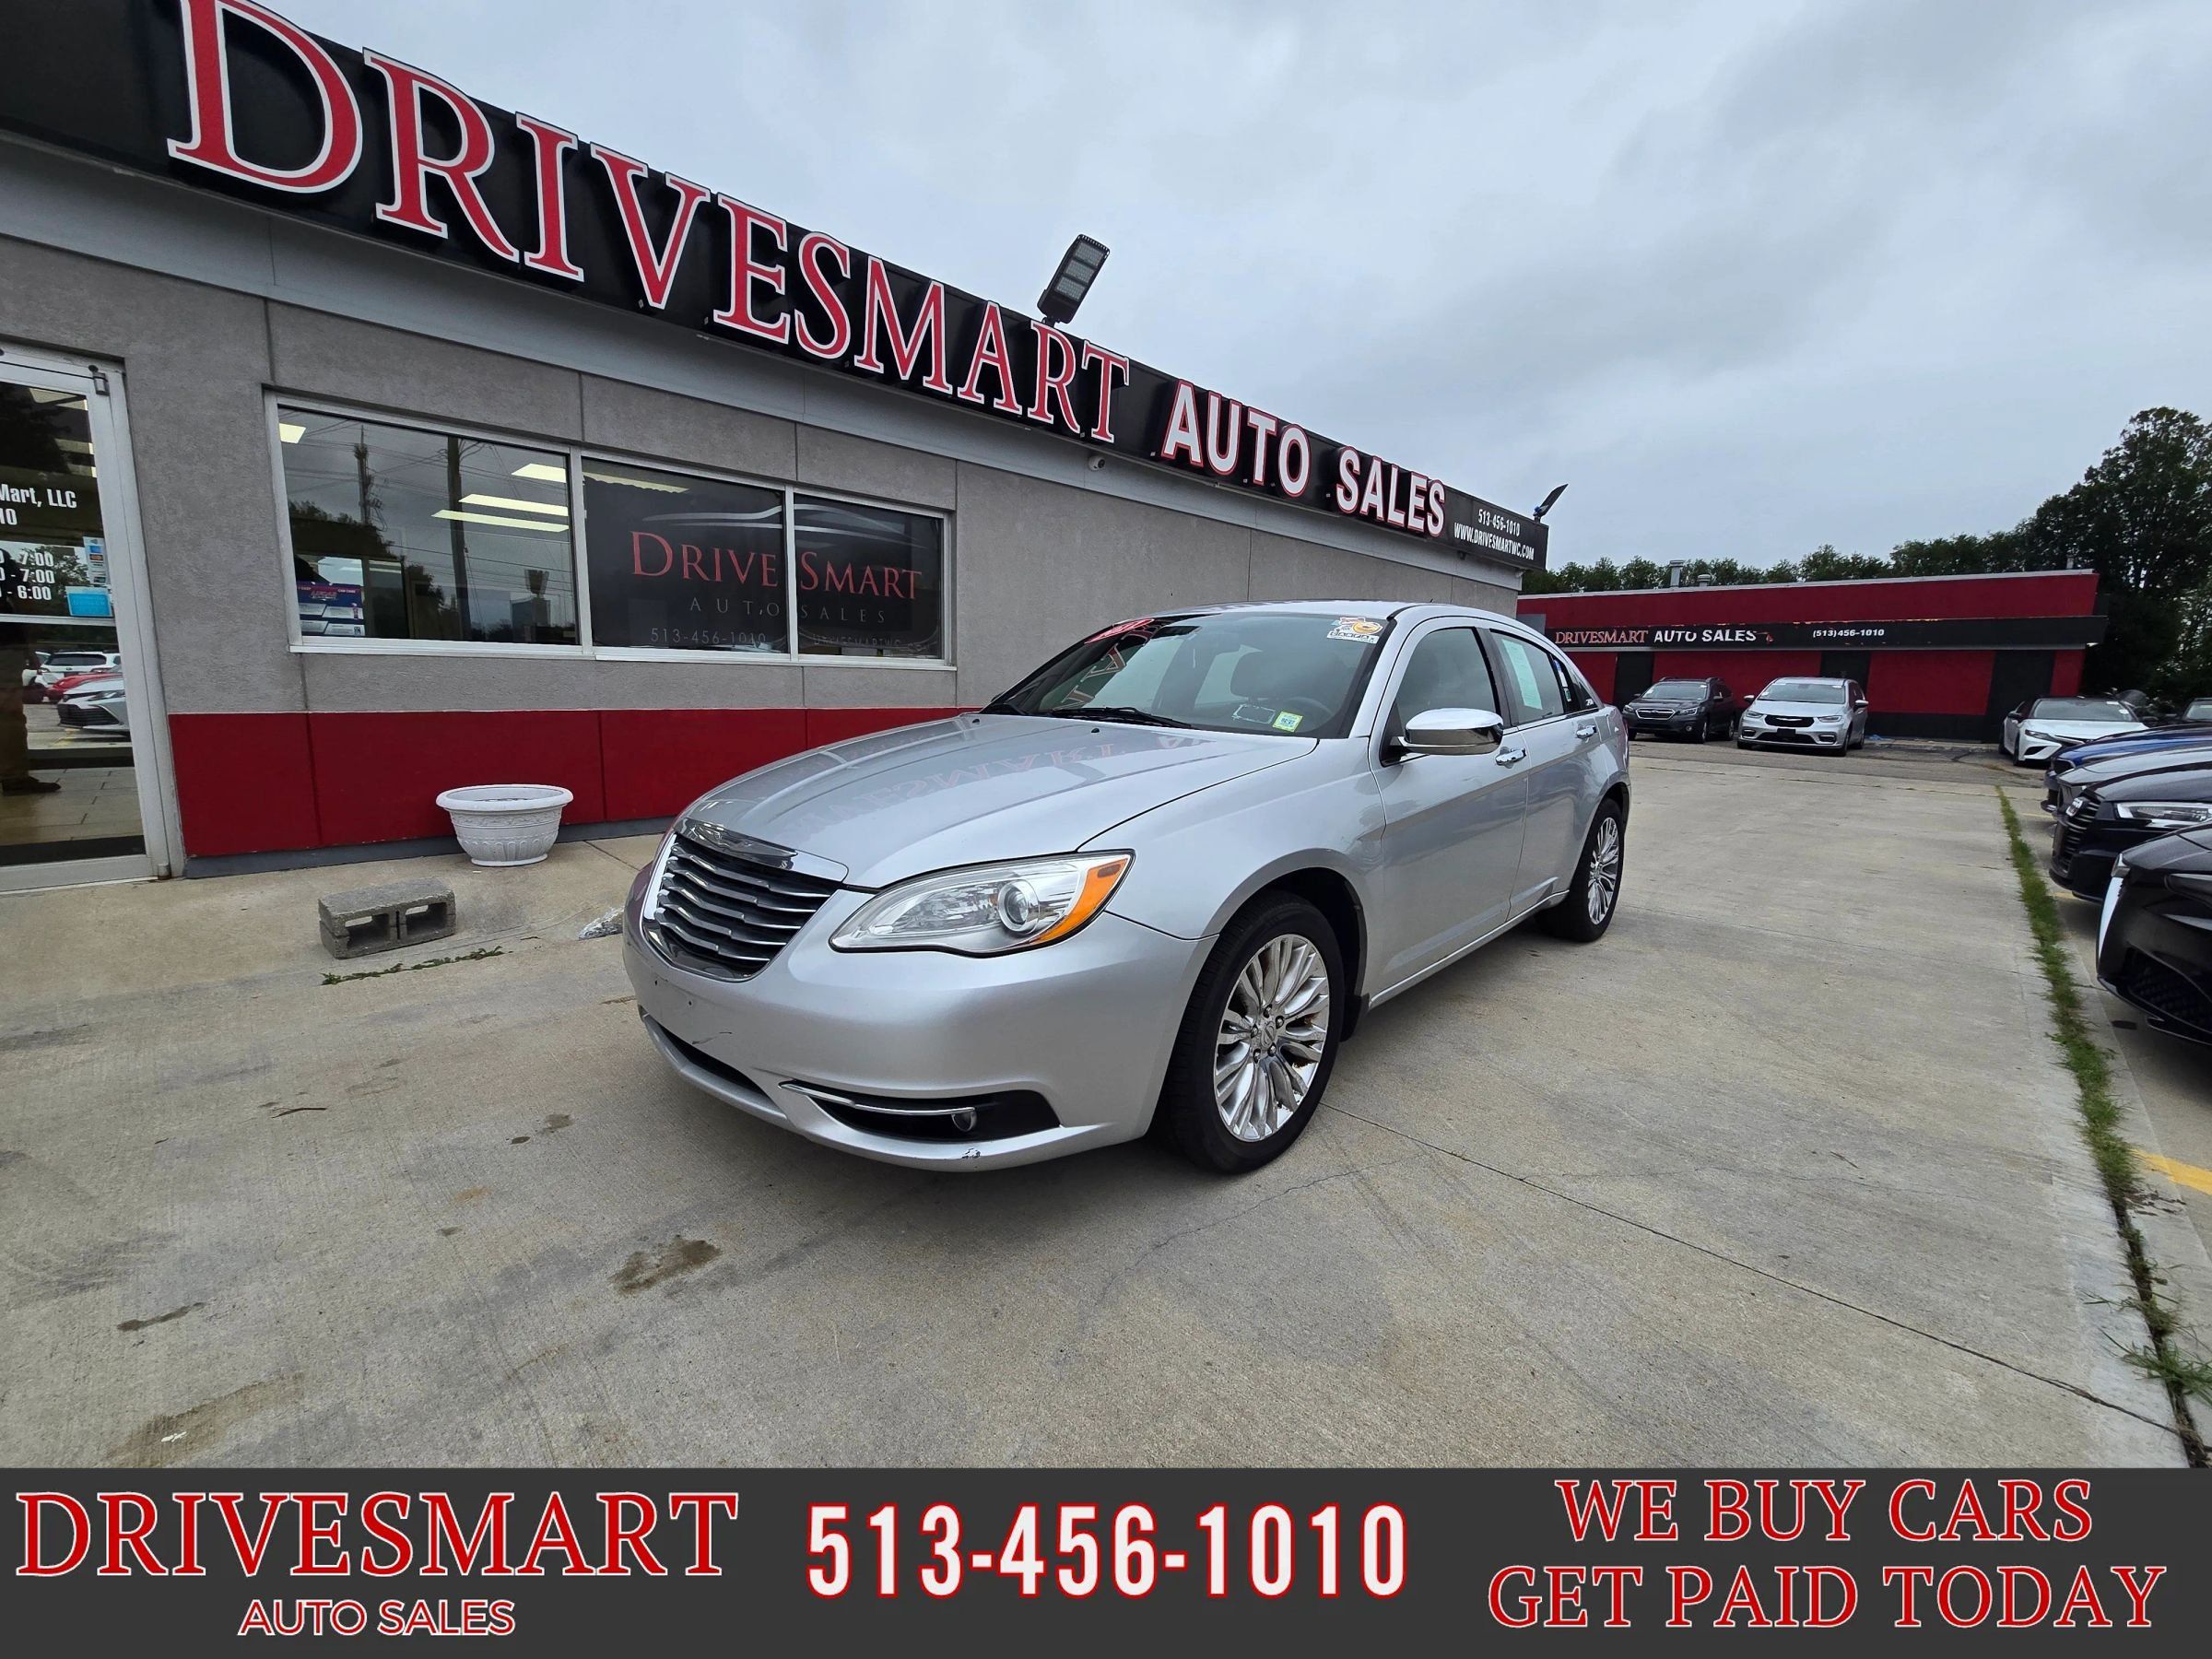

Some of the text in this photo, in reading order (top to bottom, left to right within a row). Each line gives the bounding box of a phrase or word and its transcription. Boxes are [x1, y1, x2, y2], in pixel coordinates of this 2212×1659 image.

[167, 0, 1130, 445] DRIVESMART
[1160, 378, 1446, 537] AUTO SALES
[46, 488, 77, 509] LLC
[1477, 508, 1521, 537] 513-456-1010
[1453, 522, 1535, 559] WWW.DRIVESMARTWC.COM
[19, 568, 55, 584] 7:00
[630, 531, 923, 600] DRIVE SMART
[17, 584, 53, 601] 6:00
[690, 597, 886, 624] AUTO SALES
[650, 627, 767, 644] 513-456-1010
[1554, 629, 1758, 644] DRIVESMART AUTO SALES
